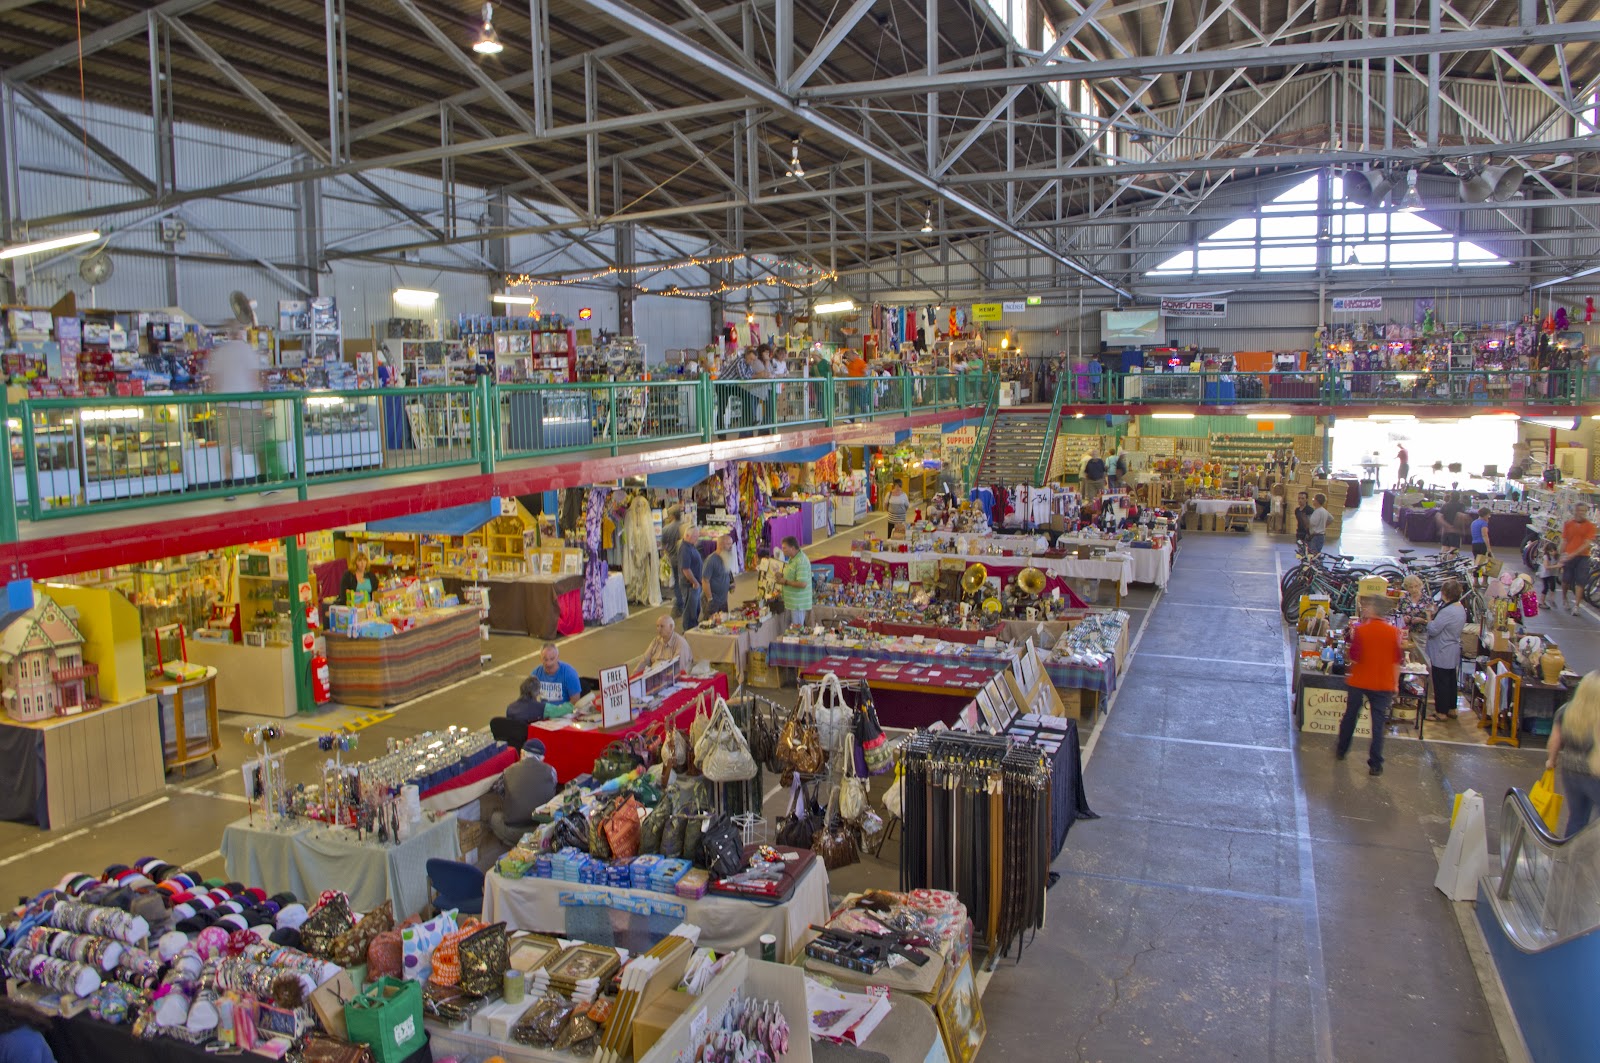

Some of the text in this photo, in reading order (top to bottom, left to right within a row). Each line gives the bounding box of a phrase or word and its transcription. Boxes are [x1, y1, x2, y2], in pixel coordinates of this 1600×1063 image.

[165, 221, 186, 240] 52
[1161, 300, 1213, 310] COMPUTERS
[946, 436, 974, 445] SUPPLIES
[1036, 493, 1048, 504] 34
[606, 669, 622, 684] FREE
[603, 679, 628, 699] STRESS
[610, 694, 623, 708] TEST
[1314, 708, 1369, 720] ANTIES
[1309, 721, 1337, 731] OLDE
